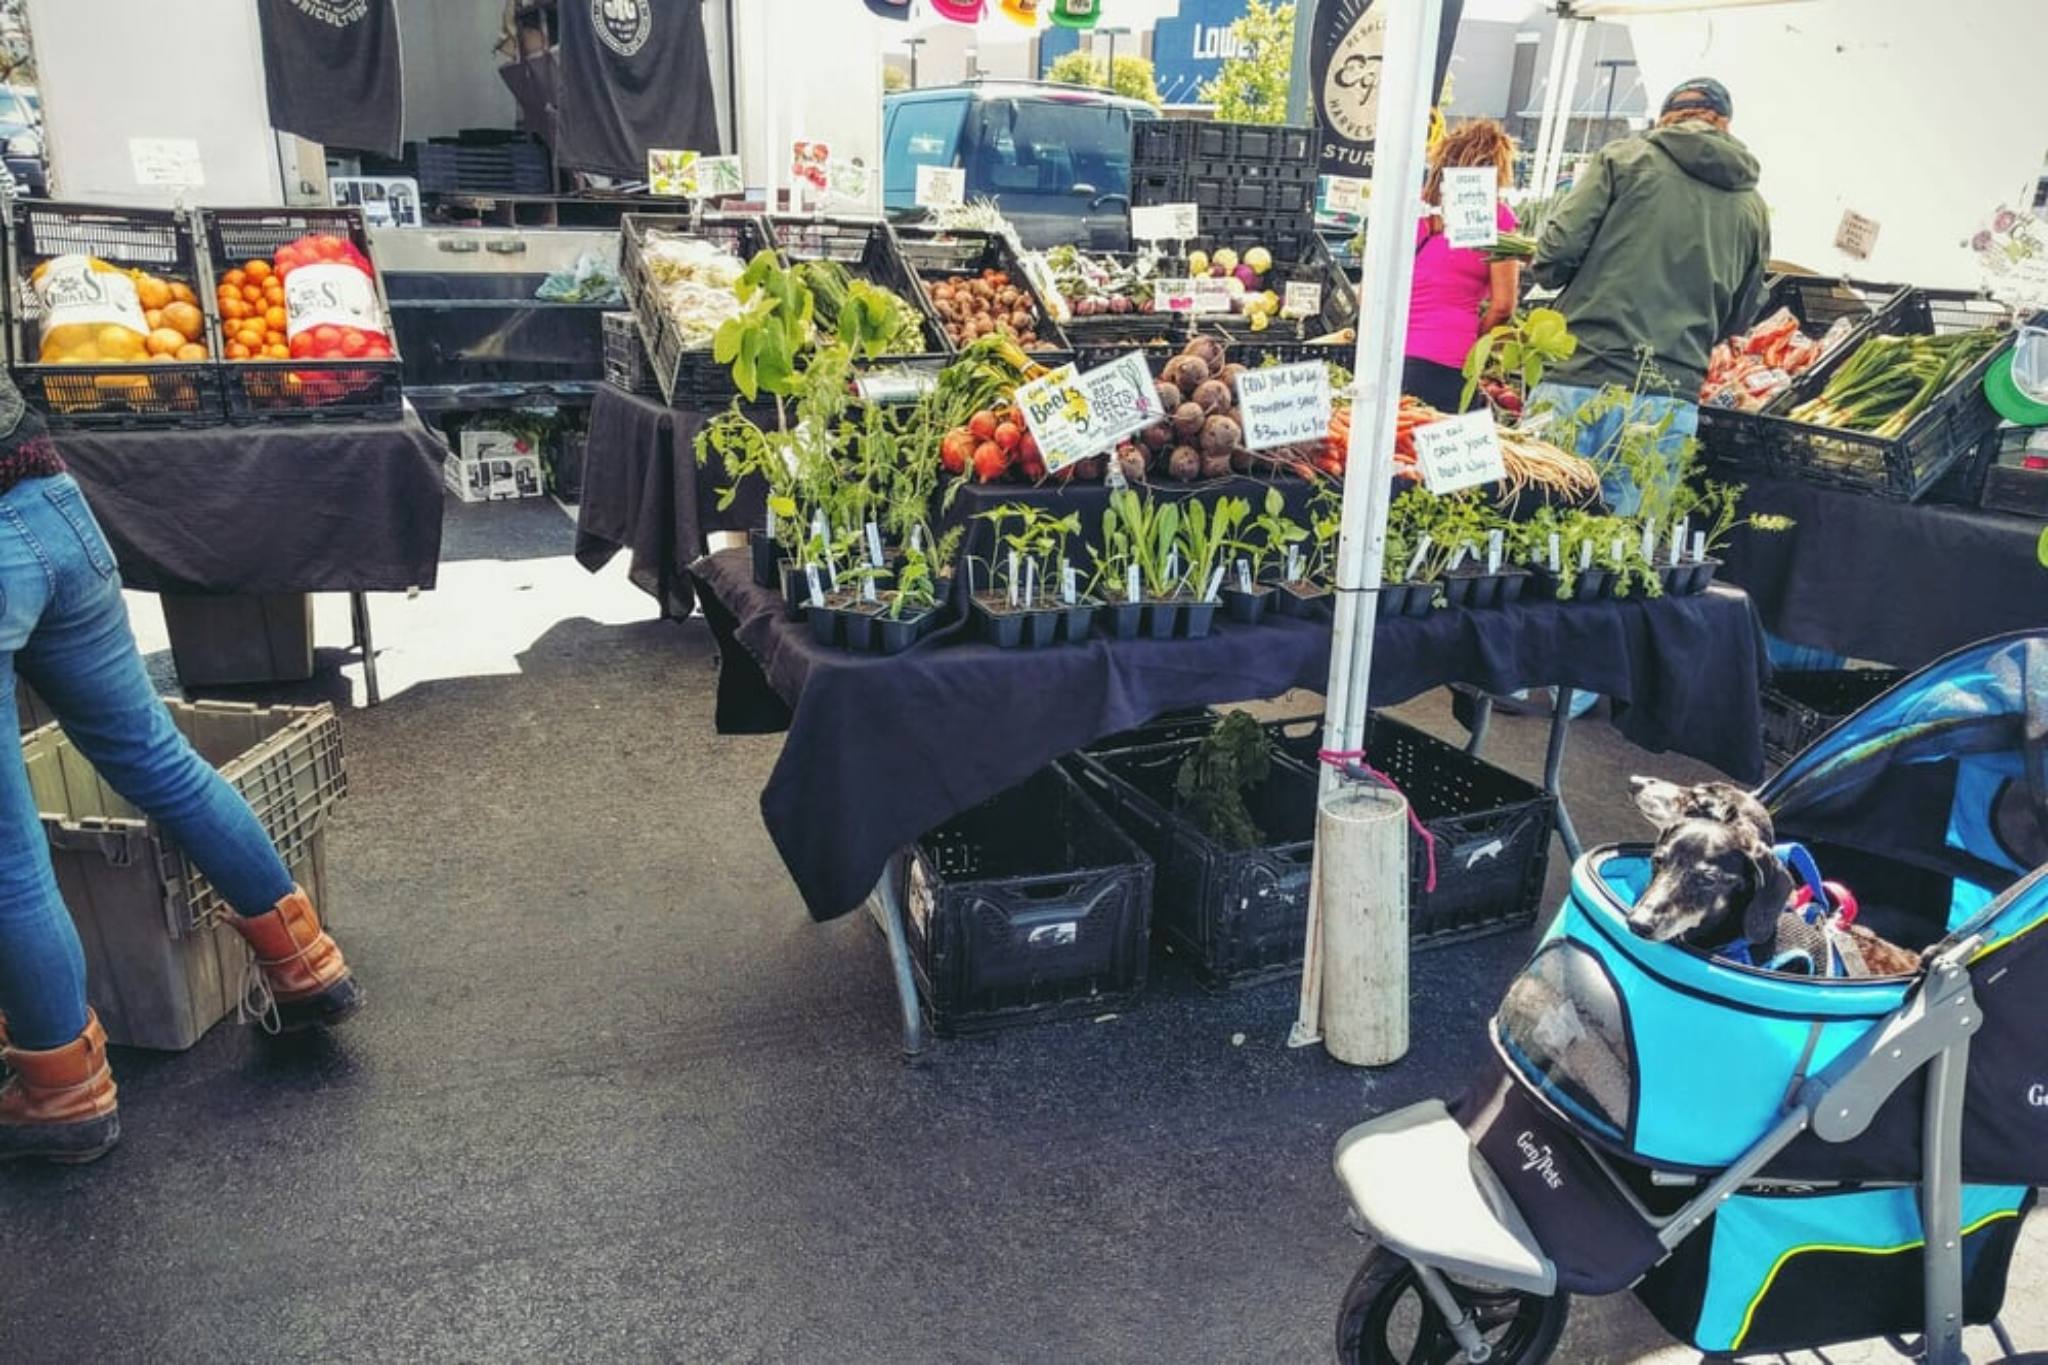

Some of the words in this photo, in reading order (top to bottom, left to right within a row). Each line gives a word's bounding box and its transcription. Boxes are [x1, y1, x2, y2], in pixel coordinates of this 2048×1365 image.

[1327, 98, 1378, 137] HARVES
[1029, 386, 1082, 425] Beets
[1516, 1130, 1564, 1189] Gen7Pets
